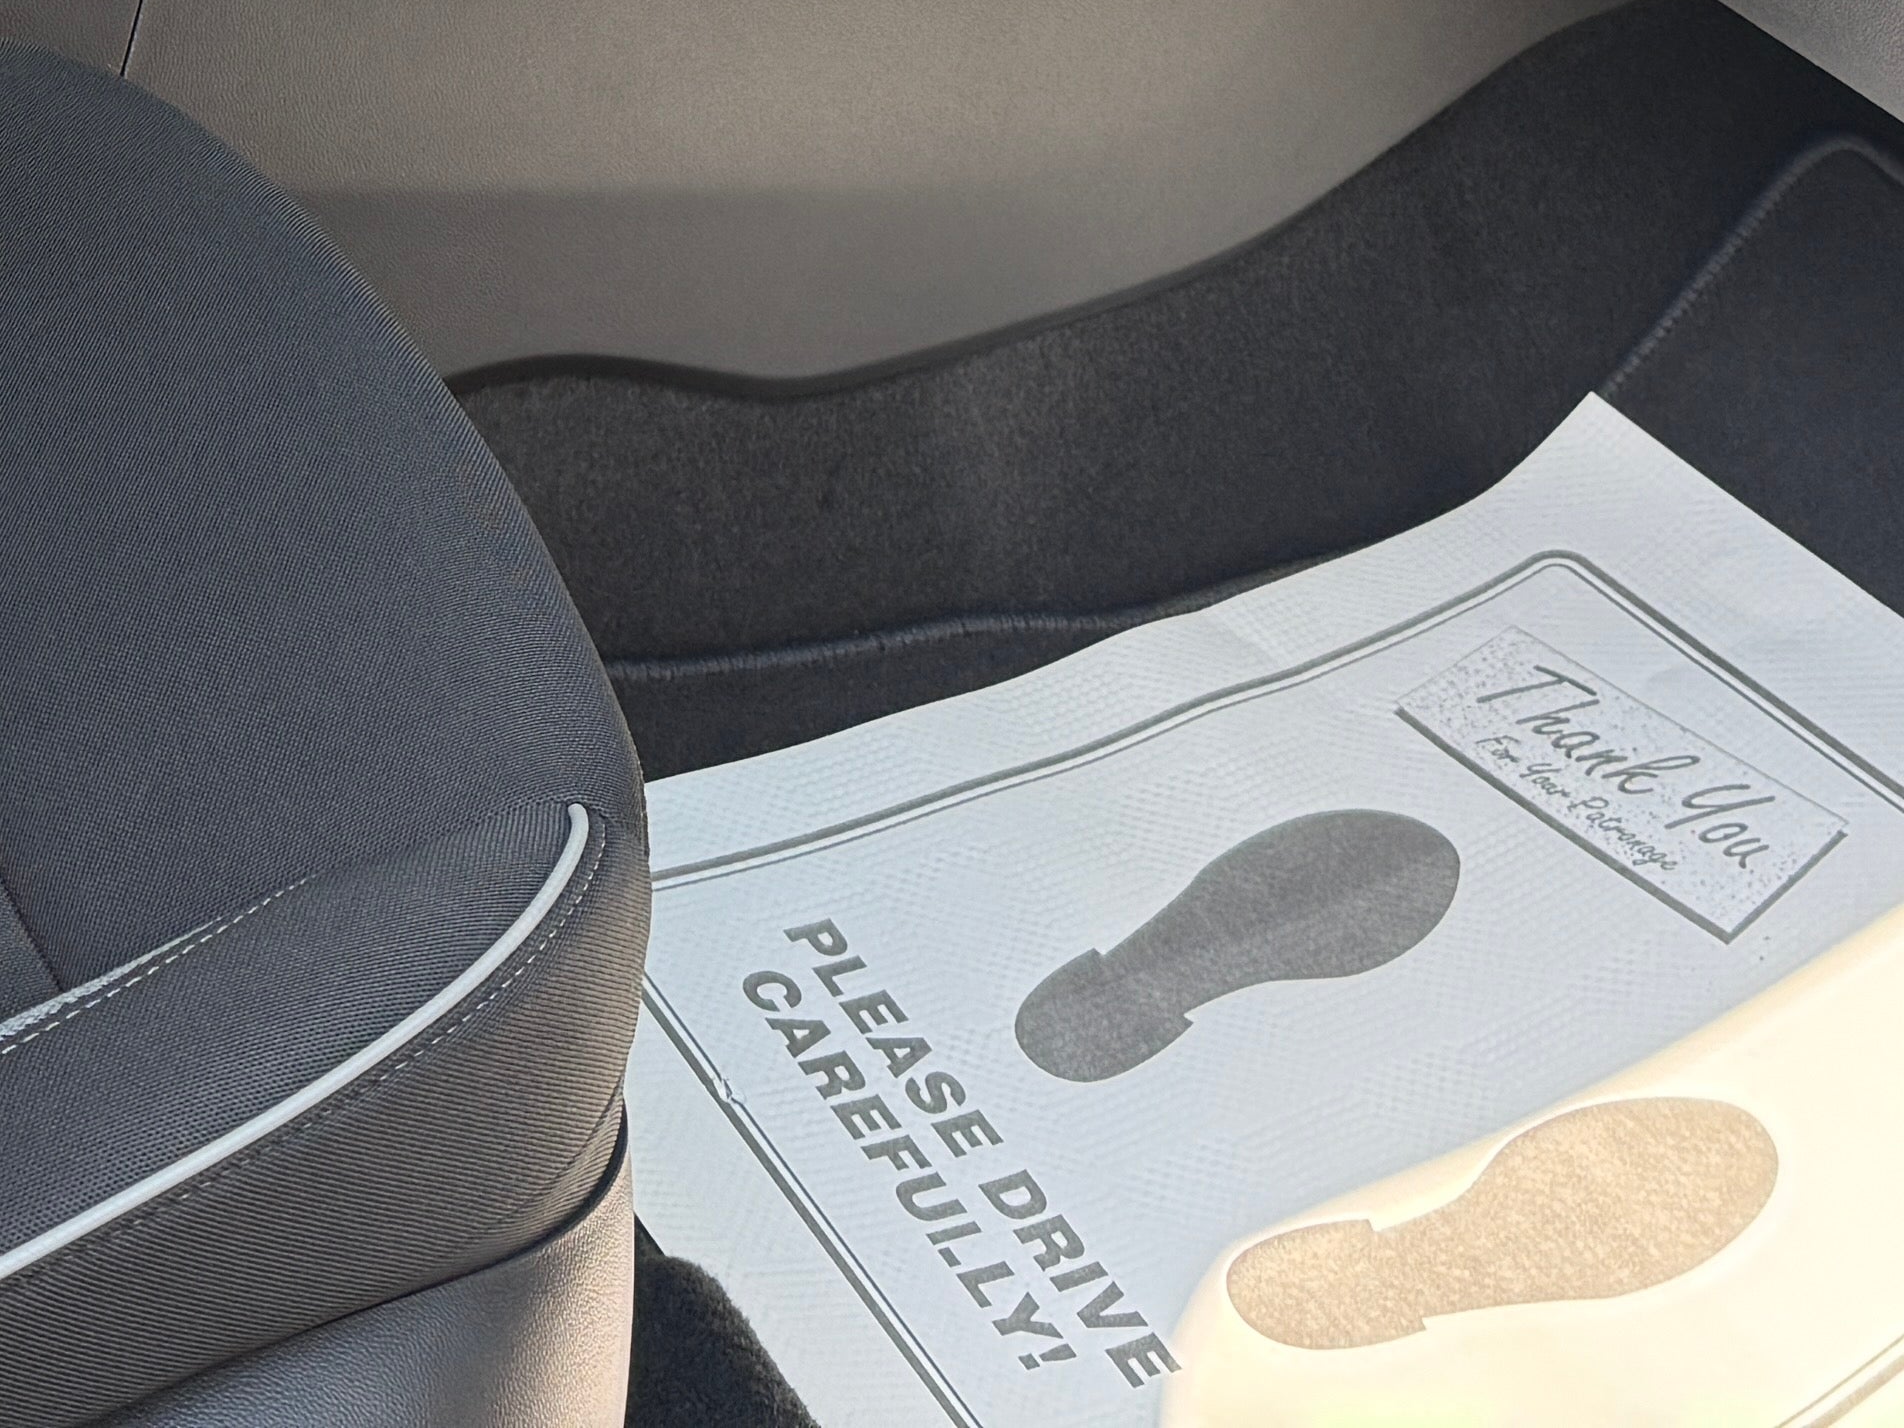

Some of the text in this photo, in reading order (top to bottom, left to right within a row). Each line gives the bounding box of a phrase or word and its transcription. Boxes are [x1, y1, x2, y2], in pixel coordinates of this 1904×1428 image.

[1475, 734, 1677, 872] For Your Patronage
[1476, 664, 1777, 870] Thank You
[742, 970, 1077, 1371] CAREFULLY!
[783, 918, 1183, 1389] PLEASE DRIVE
